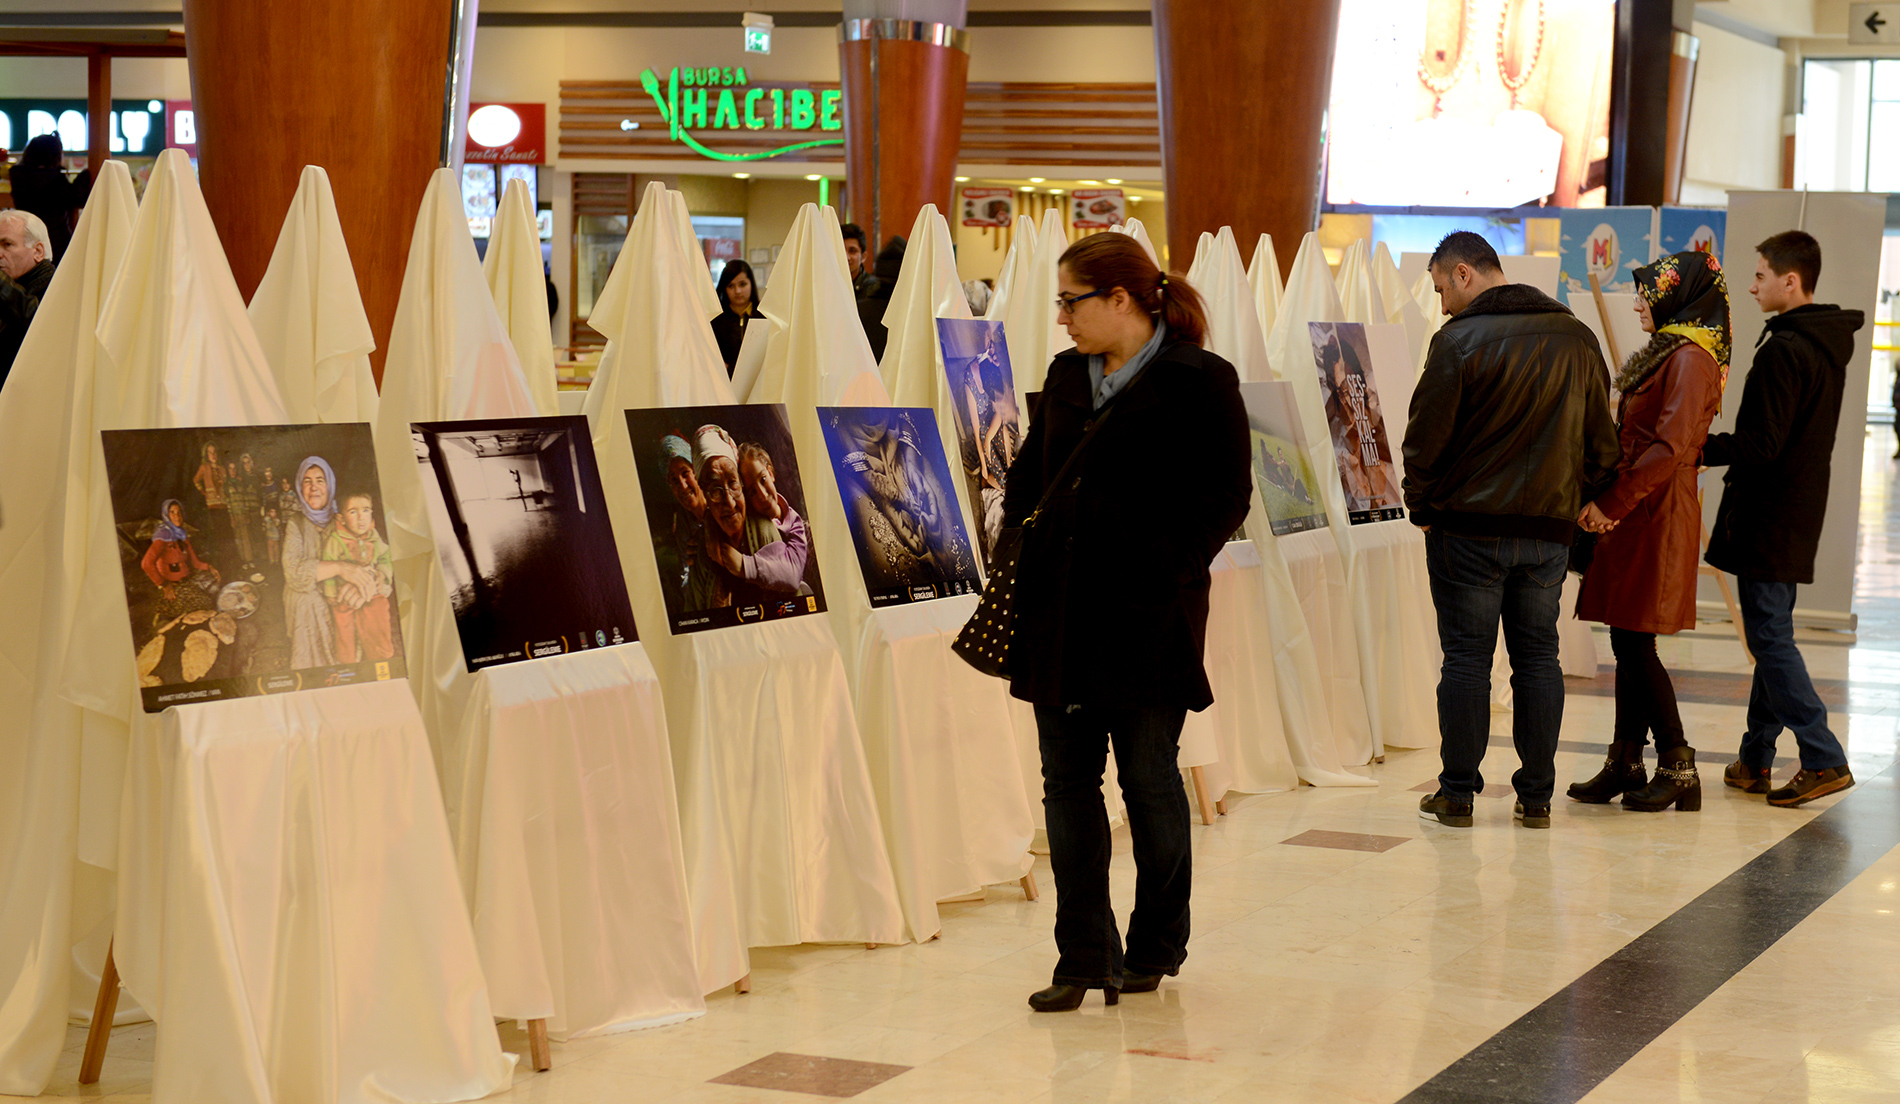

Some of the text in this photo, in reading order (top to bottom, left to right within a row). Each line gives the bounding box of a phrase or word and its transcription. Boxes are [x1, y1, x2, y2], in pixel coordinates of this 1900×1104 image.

[683, 67, 747, 86] BURSA
[1346, 374, 1366, 397] SES-
[1356, 420, 1376, 443] KAL-
[1361, 442, 1381, 467] MA!
